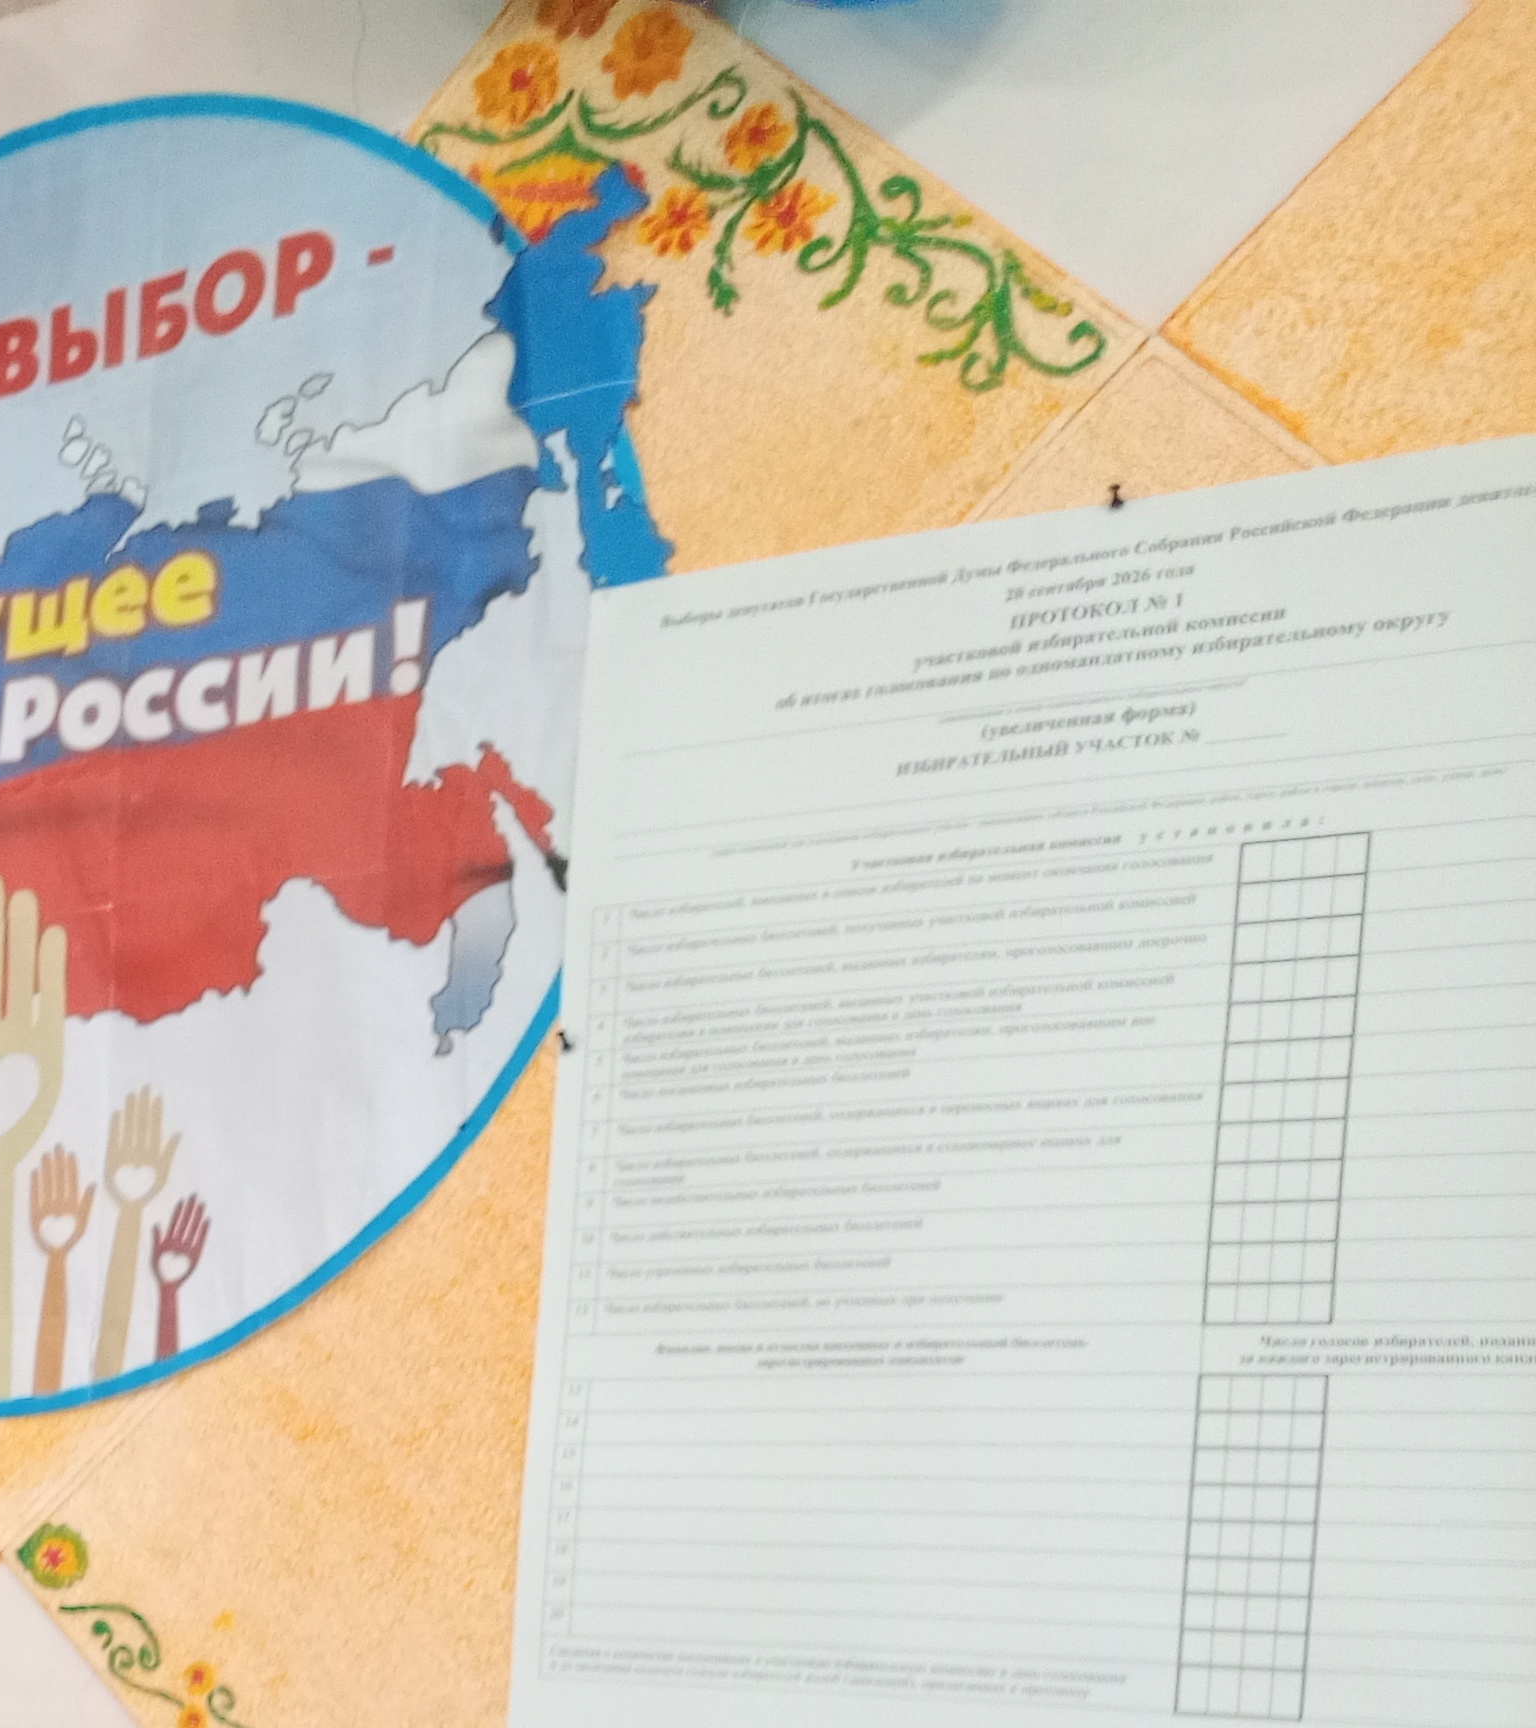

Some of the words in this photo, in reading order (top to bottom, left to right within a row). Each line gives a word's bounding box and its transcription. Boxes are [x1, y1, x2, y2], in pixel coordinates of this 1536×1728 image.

[808, 570, 947, 607] Государственной
[951, 562, 1002, 585] Думы
[1005, 542, 1129, 577] Федерального
[1133, 527, 1225, 557] Собрания
[1229, 510, 1336, 543] Российской
[1340, 492, 1452, 526] Федерации
[1027, 574, 1107, 600] сентября
[1110, 567, 1151, 587] 2026
[1155, 560, 1198, 581] года
[909, 639, 1022, 673] участковой
[1026, 617, 1180, 657] избирательной
[1184, 602, 1290, 635] комиссии
[1006, 596, 1137, 632] ПРОТОКОЛ
[1144, 592, 1166, 613] №
[1173, 589, 1186, 609] 1
[771, 692, 797, 712] об
[800, 683, 861, 708] итогах
[865, 667, 984, 700] голосования
[988, 663, 1012, 684] по
[1016, 639, 1187, 680] одномандатному
[1192, 615, 1368, 658] избирательному
[1373, 604, 1453, 634] округу
[976, 707, 1116, 743] (увеличенная
[1120, 697, 1199, 725] форма)
[893, 740, 1068, 778] ИЗБИРАТЕЛЬНЫЙ
[1074, 727, 1173, 757] УЧАСТОК
[1179, 723, 1203, 745] №
